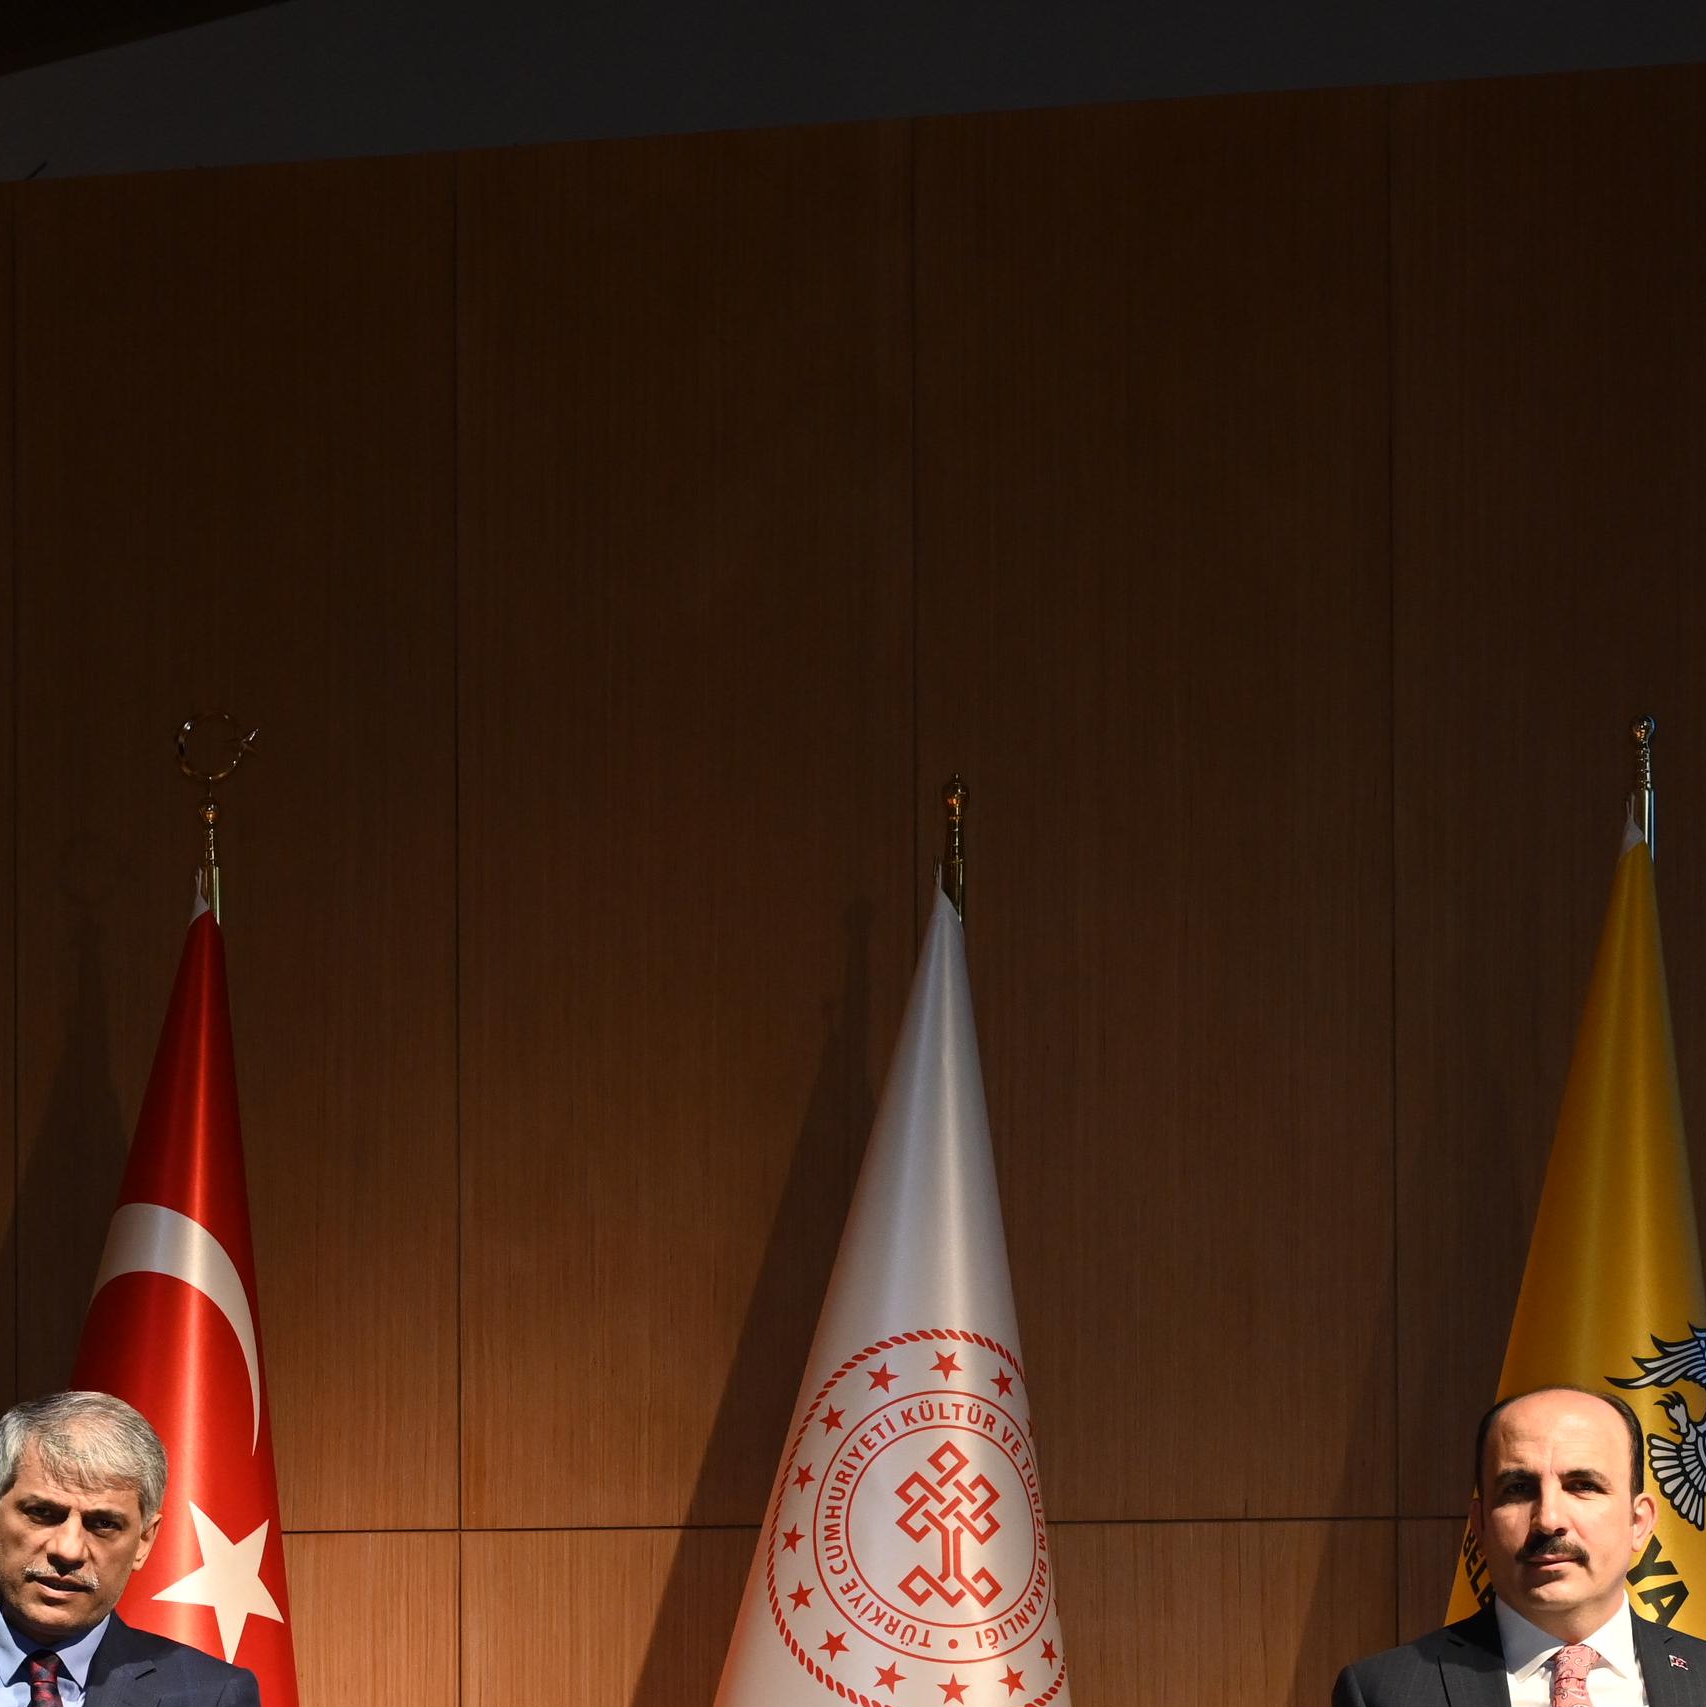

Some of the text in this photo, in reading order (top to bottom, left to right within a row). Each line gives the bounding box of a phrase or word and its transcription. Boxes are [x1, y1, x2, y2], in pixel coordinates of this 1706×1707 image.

[900, 1400, 997, 1433] KÜLTÜR
[1001, 1426, 1023, 1458] VE
[823, 1414, 897, 1576] CUMHURİYETİ
[839, 1577, 932, 1649] TÜRKİYE
[975, 1559, 1048, 1650] BAKANLIĞI
